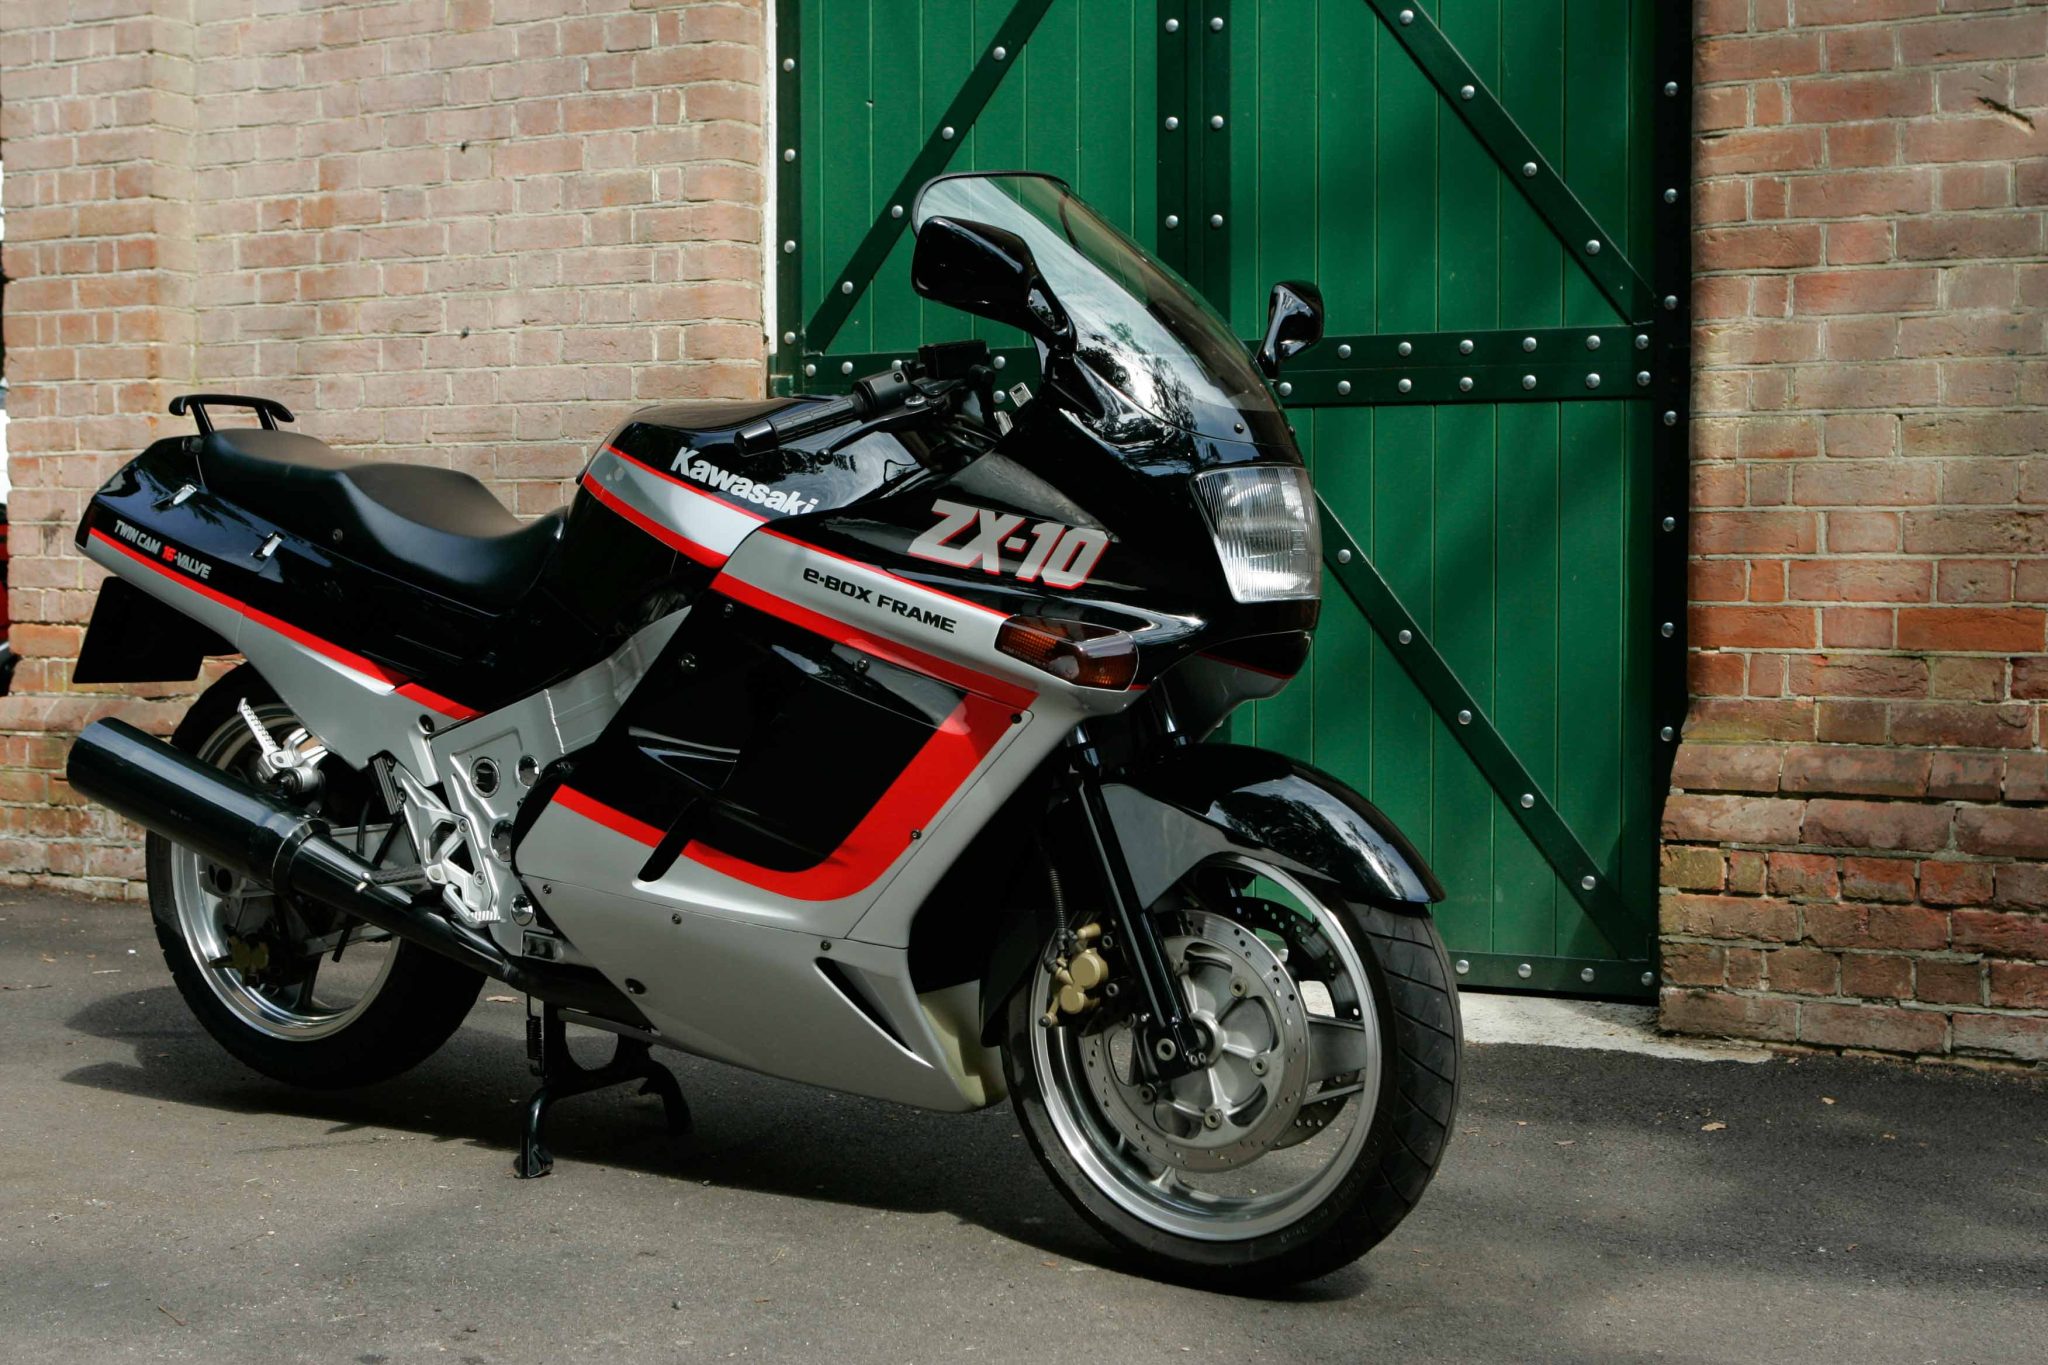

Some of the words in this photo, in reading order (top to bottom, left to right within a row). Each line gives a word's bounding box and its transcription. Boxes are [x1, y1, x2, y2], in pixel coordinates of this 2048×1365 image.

[670, 446, 819, 515] Kawasaki
[115, 520, 138, 542] TWIN
[138, 533, 161, 553] CAM
[162, 546, 211, 579] 16-VALVE
[907, 498, 1111, 590] ZX-10
[803, 567, 873, 604] e-BOX
[876, 594, 957, 634] FRAME
